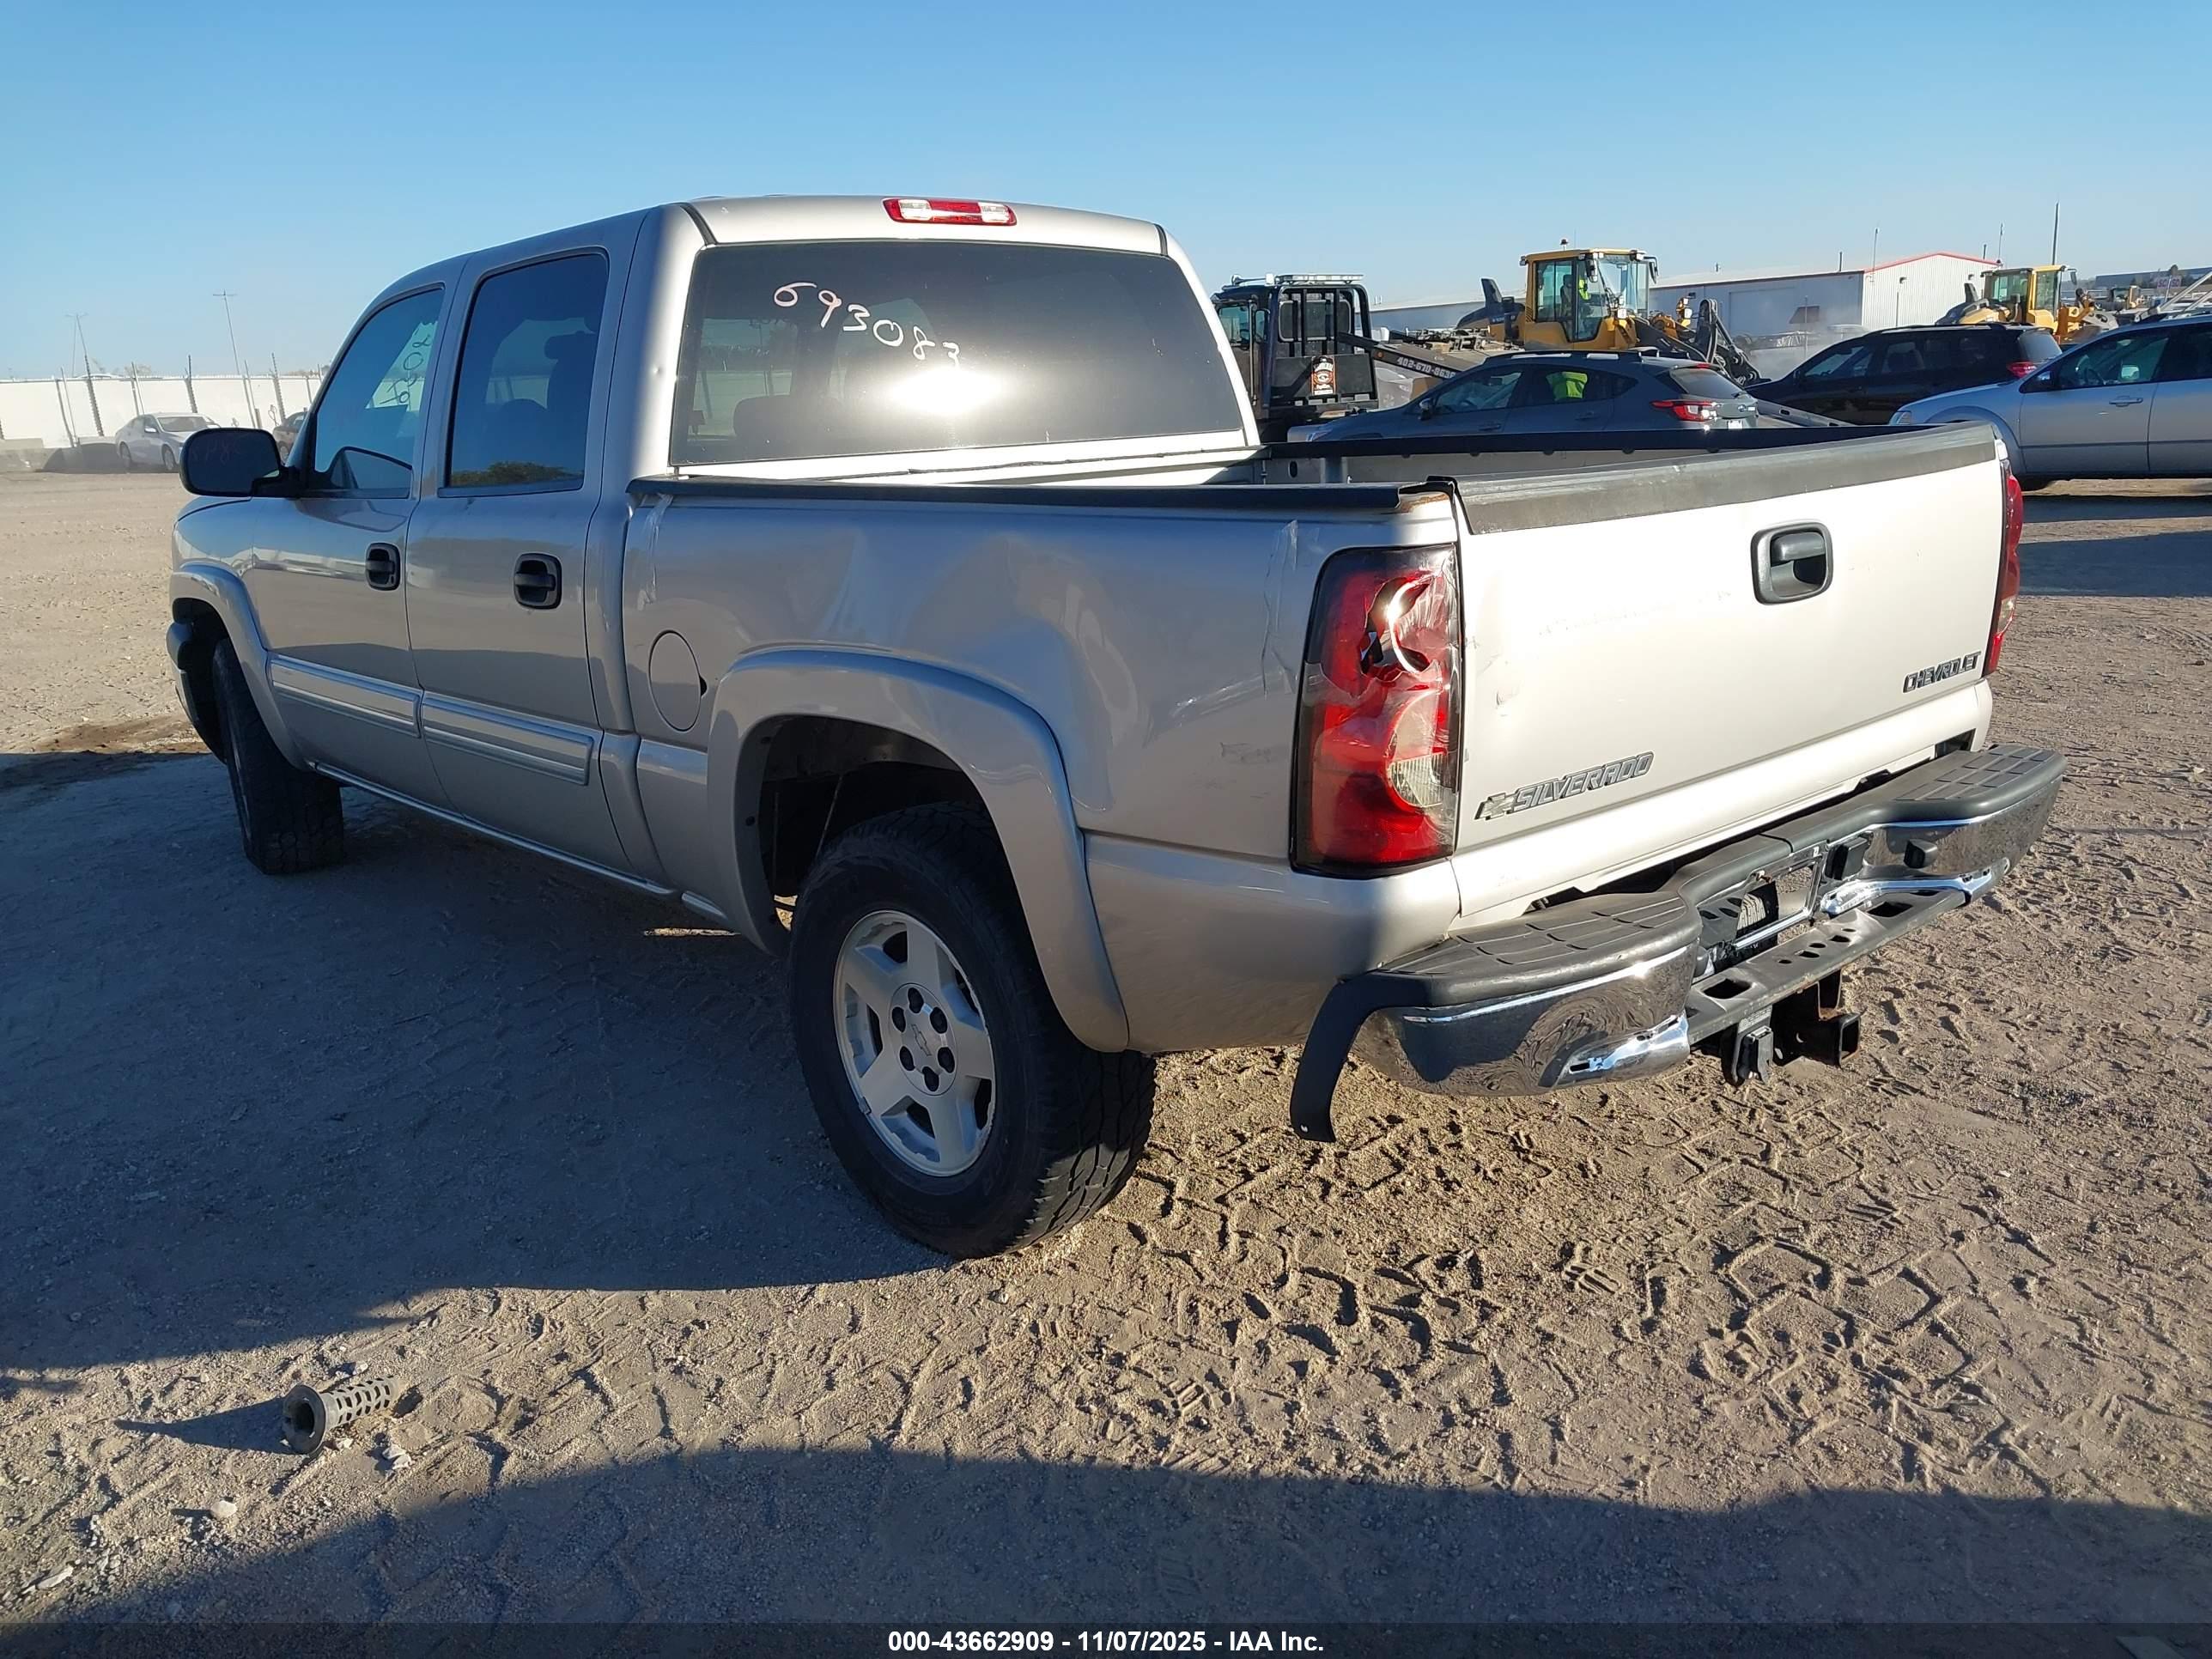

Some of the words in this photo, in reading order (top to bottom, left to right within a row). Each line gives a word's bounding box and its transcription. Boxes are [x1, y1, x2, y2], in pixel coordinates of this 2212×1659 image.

[774, 282, 960, 368] 693083
[1903, 651, 1982, 693] CHEVROLET
[1512, 751, 1653, 813] SILVERADO
